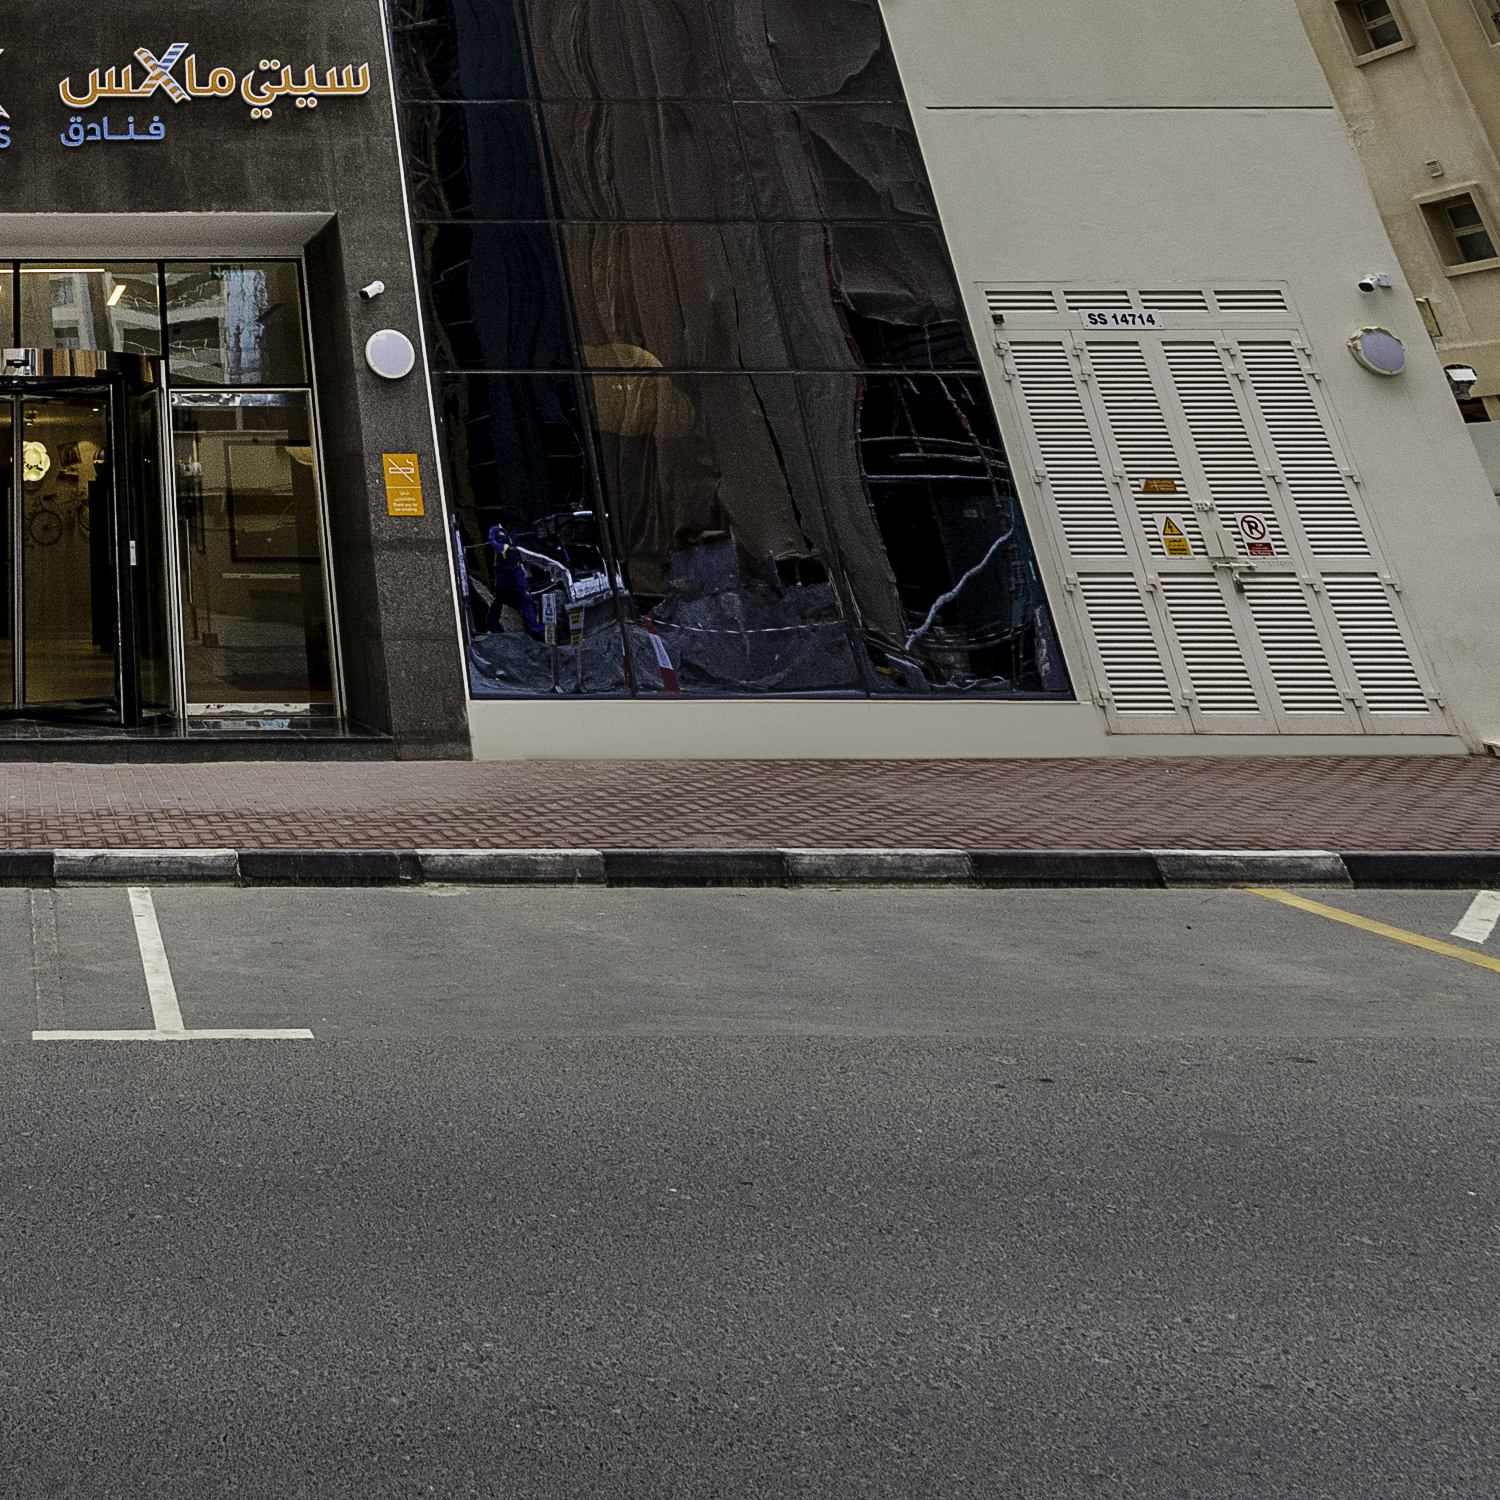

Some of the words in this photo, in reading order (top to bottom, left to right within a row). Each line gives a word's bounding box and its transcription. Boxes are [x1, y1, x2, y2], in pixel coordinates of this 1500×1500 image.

[240, 59, 372, 120] سيتي
[59, 116, 167, 148] فنادق
[1087, 312, 1108, 326] SS
[1111, 312, 1156, 326] 14714
